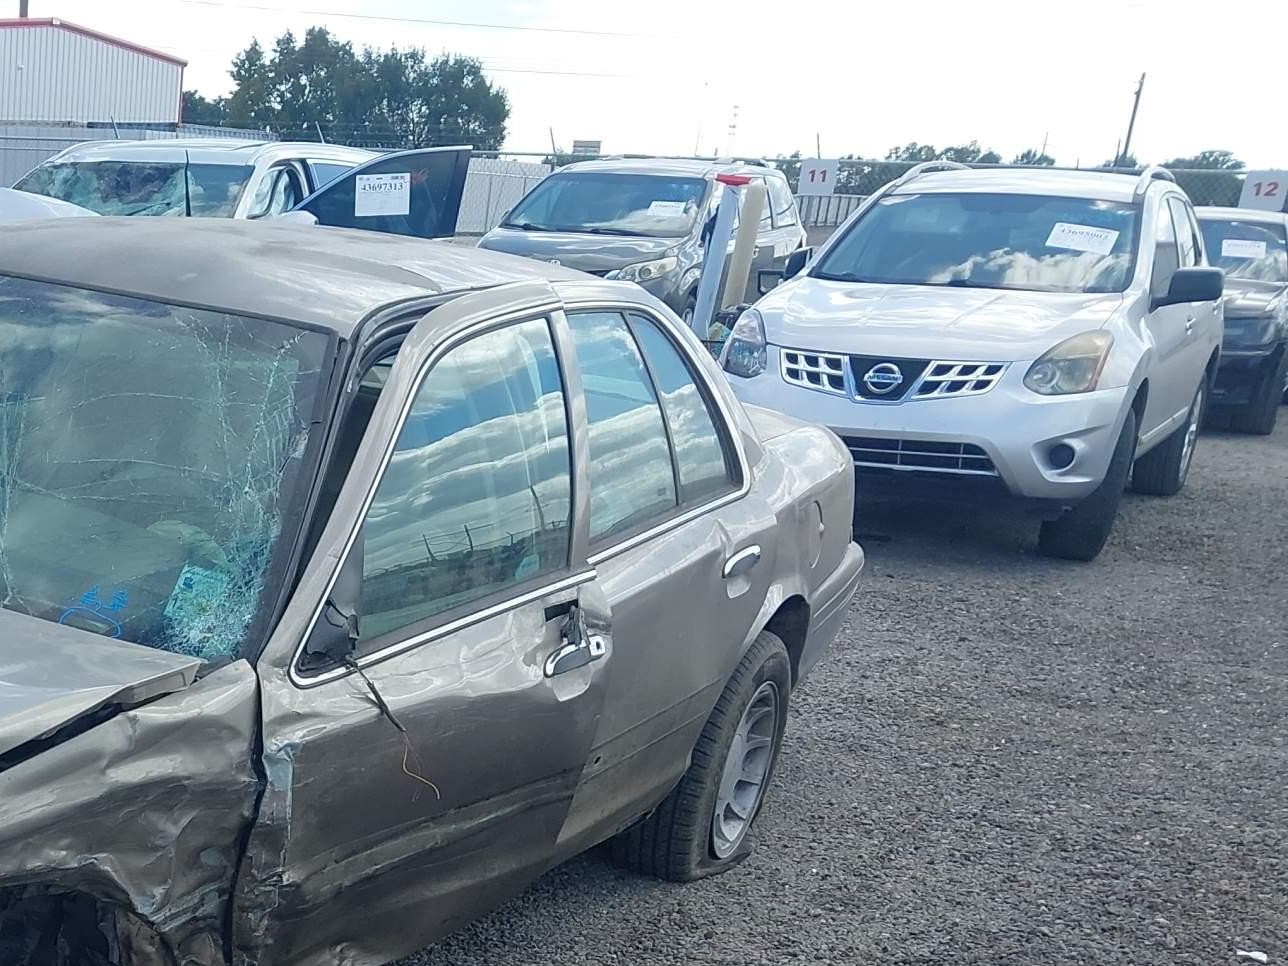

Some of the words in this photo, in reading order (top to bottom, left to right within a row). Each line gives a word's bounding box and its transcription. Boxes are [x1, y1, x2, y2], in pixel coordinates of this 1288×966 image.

[808, 169, 827, 183] 11
[1253, 181, 1280, 197] 12
[866, 374, 902, 383] NISSAN
